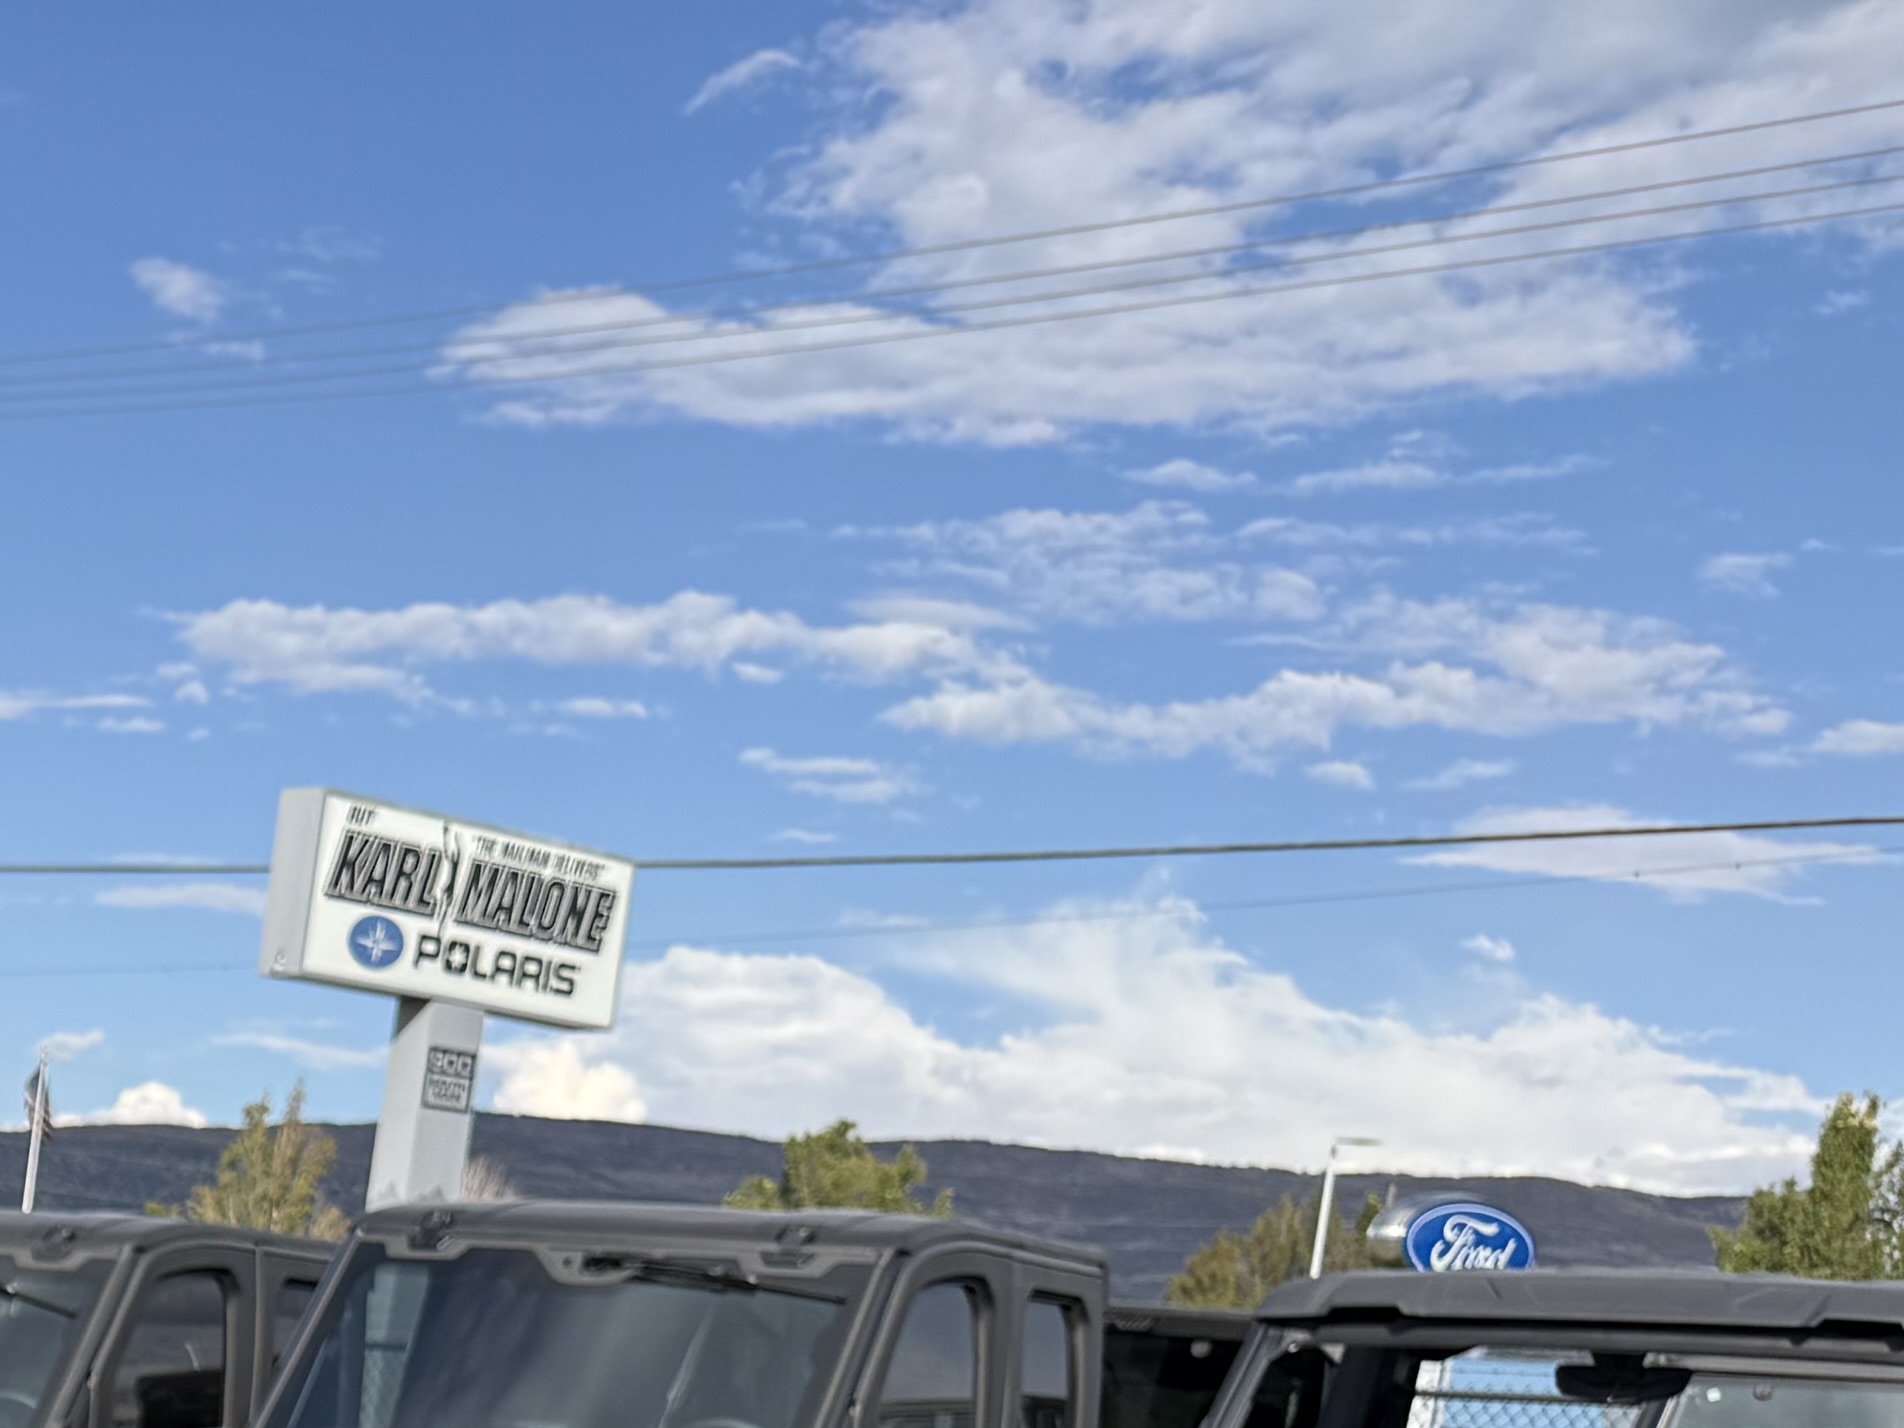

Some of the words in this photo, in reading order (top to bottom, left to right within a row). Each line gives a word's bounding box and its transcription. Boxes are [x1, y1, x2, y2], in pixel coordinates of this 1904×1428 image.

[323, 828, 443, 917] KARL
[454, 857, 617, 954] MALONE
[415, 933, 578, 996] POLARIS
[1430, 1214, 1518, 1272] Ford
